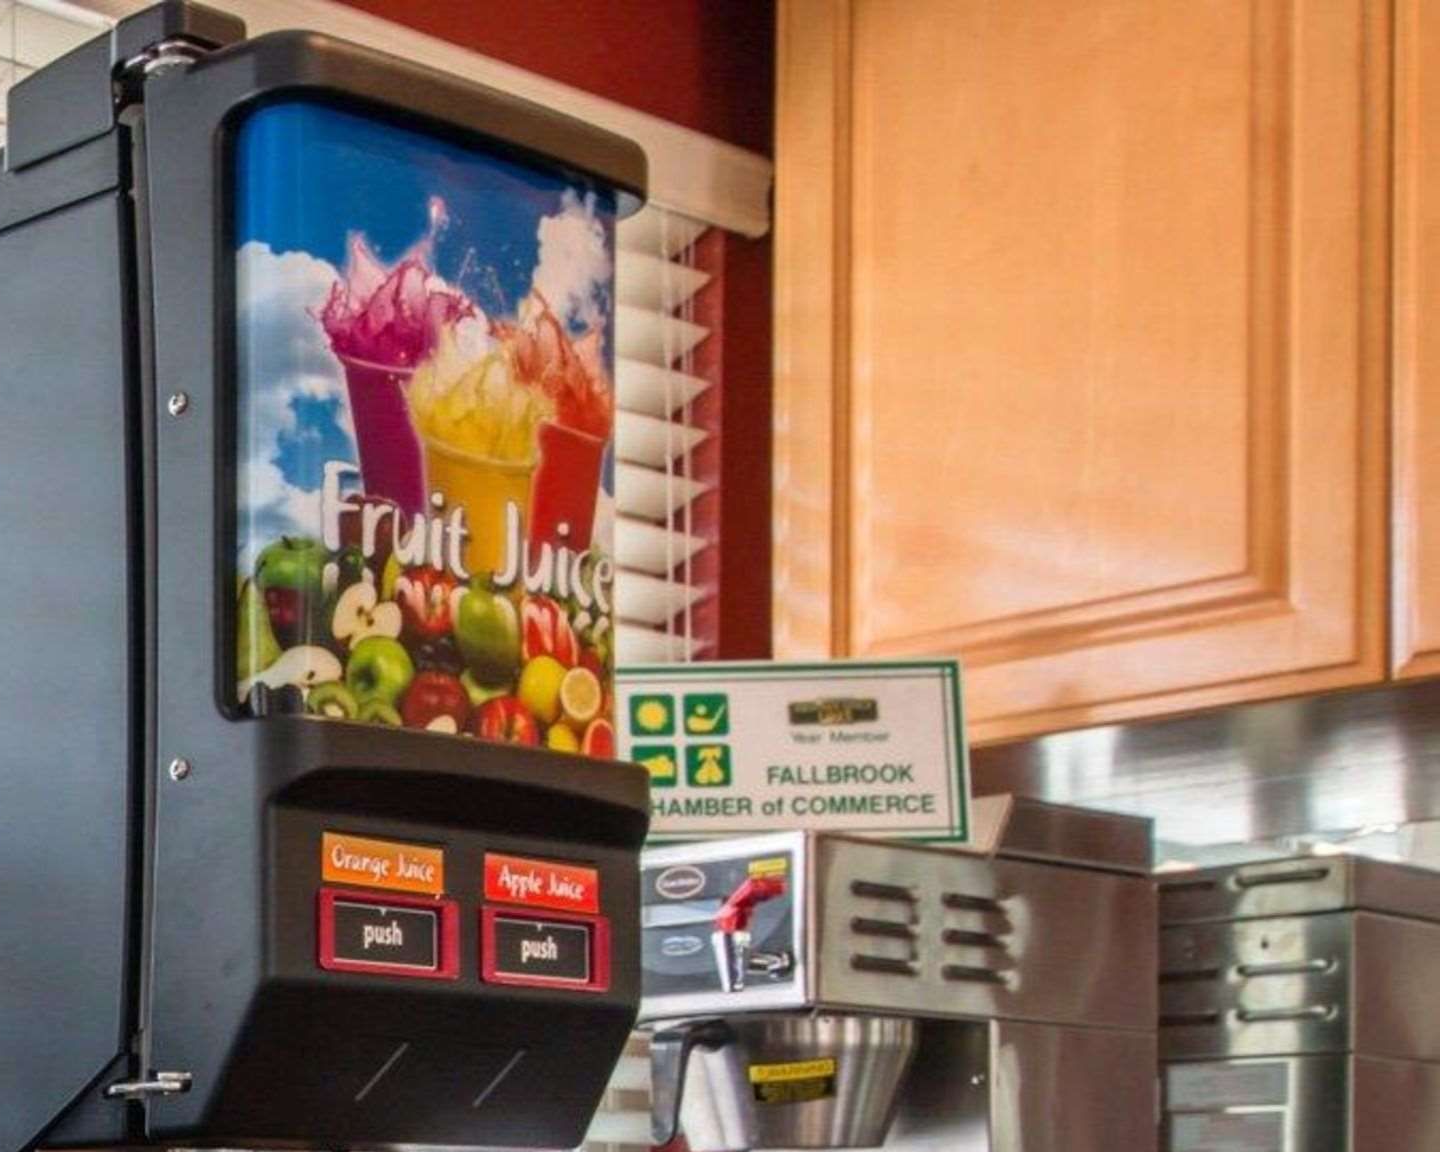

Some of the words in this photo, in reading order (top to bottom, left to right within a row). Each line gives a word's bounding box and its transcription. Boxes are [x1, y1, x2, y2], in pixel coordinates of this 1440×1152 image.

[321, 460, 470, 579] Fruit
[494, 500, 614, 612] Juice
[766, 764, 915, 785] FALLBROOK
[650, 796, 753, 818] HAMBER
[761, 796, 785, 817] of
[791, 794, 936, 816] COMMERCE
[331, 844, 390, 881] Orange
[395, 852, 434, 883] Juice
[497, 864, 543, 898] Apple
[547, 872, 585, 901] Juice
[363, 920, 403, 949] push
[521, 935, 558, 963] push
